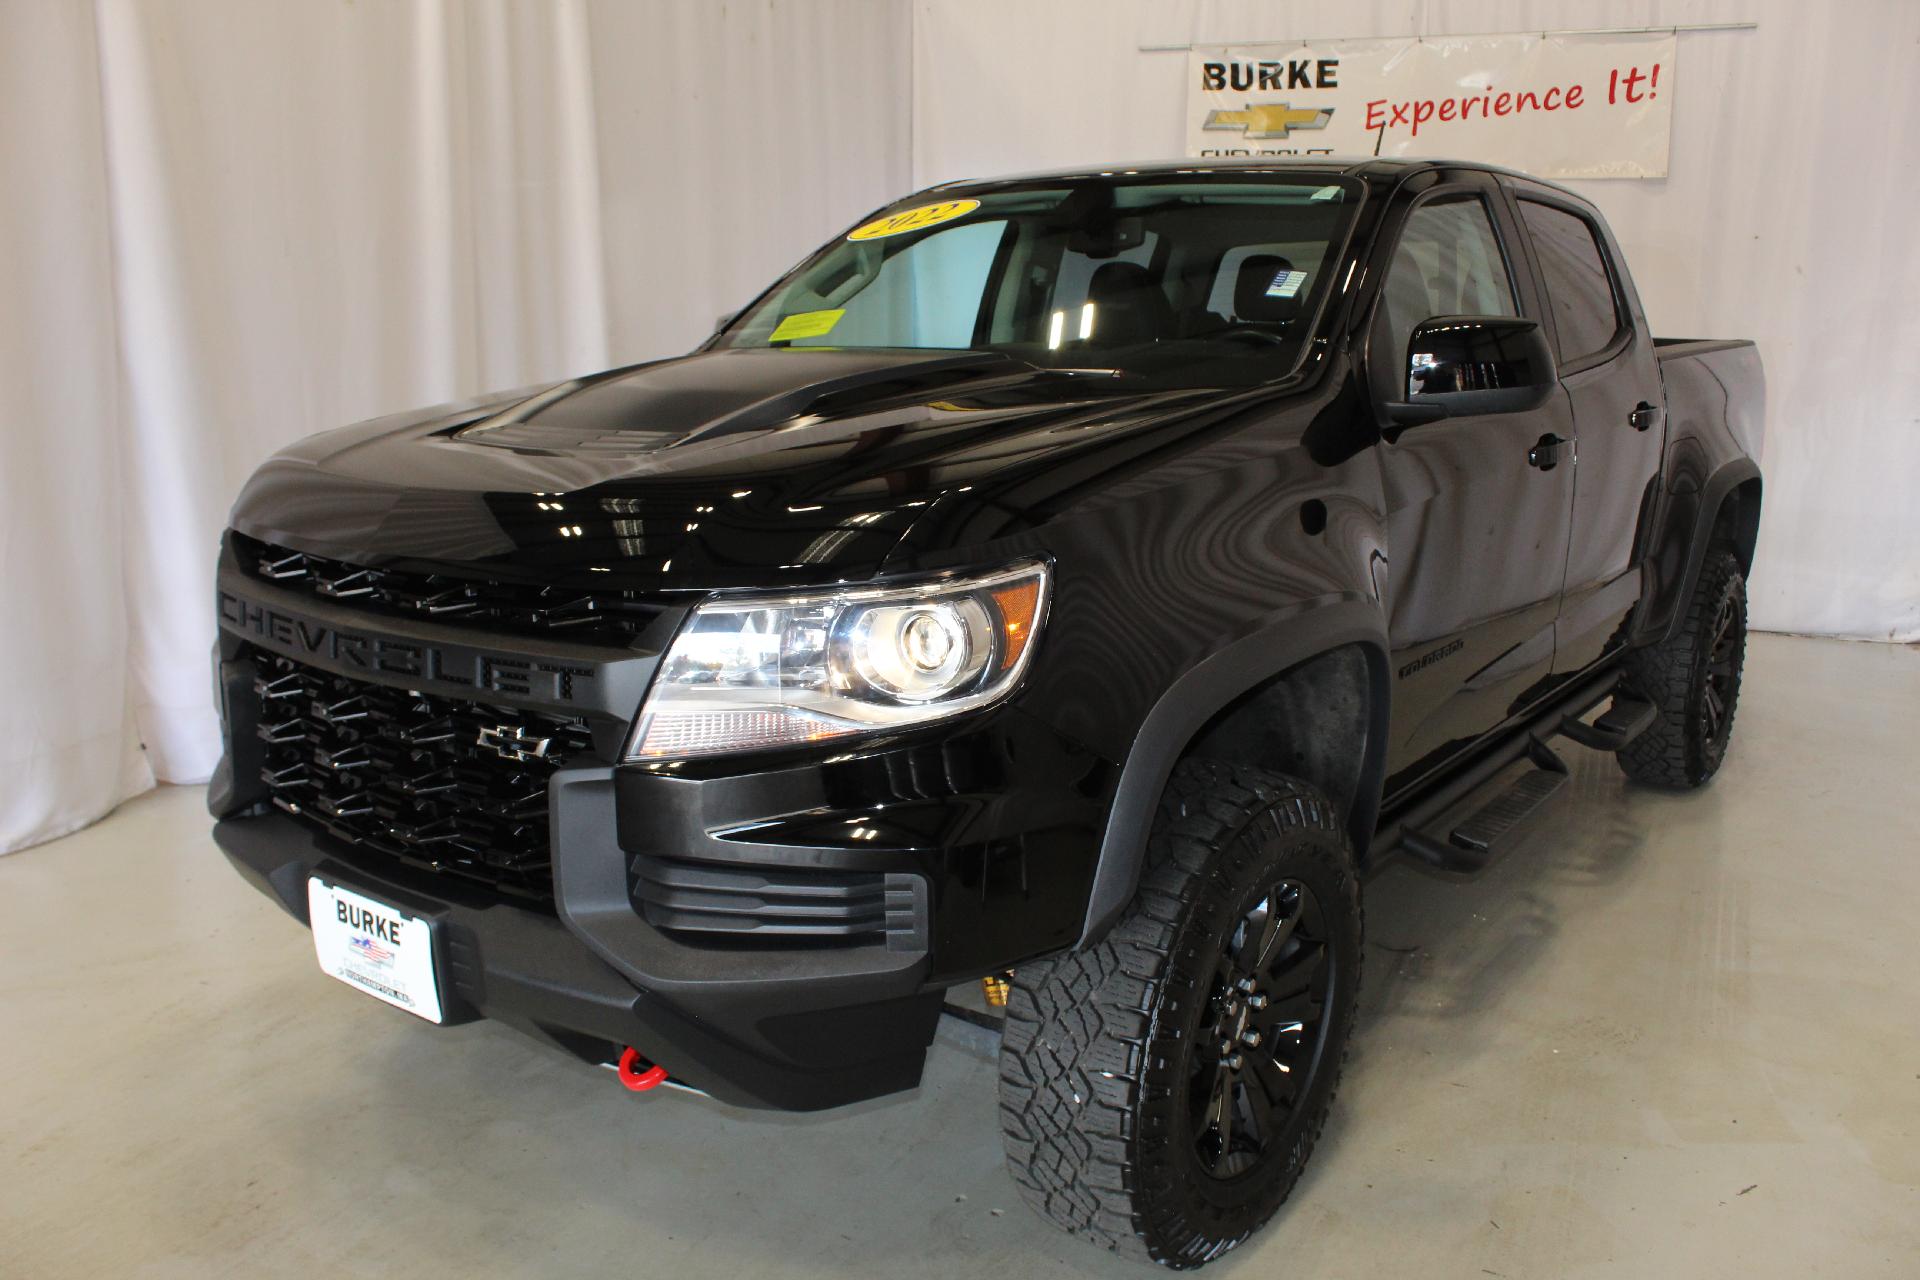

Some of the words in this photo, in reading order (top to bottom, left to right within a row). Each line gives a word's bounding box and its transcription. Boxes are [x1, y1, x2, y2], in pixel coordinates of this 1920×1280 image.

[1202, 60, 1340, 92] BURKE
[1365, 85, 1585, 136] Experience
[1608, 63, 1661, 105] It!
[863, 203, 961, 237] 2022
[219, 591, 595, 700] CHEVROLET
[336, 899, 401, 947] BURKE
